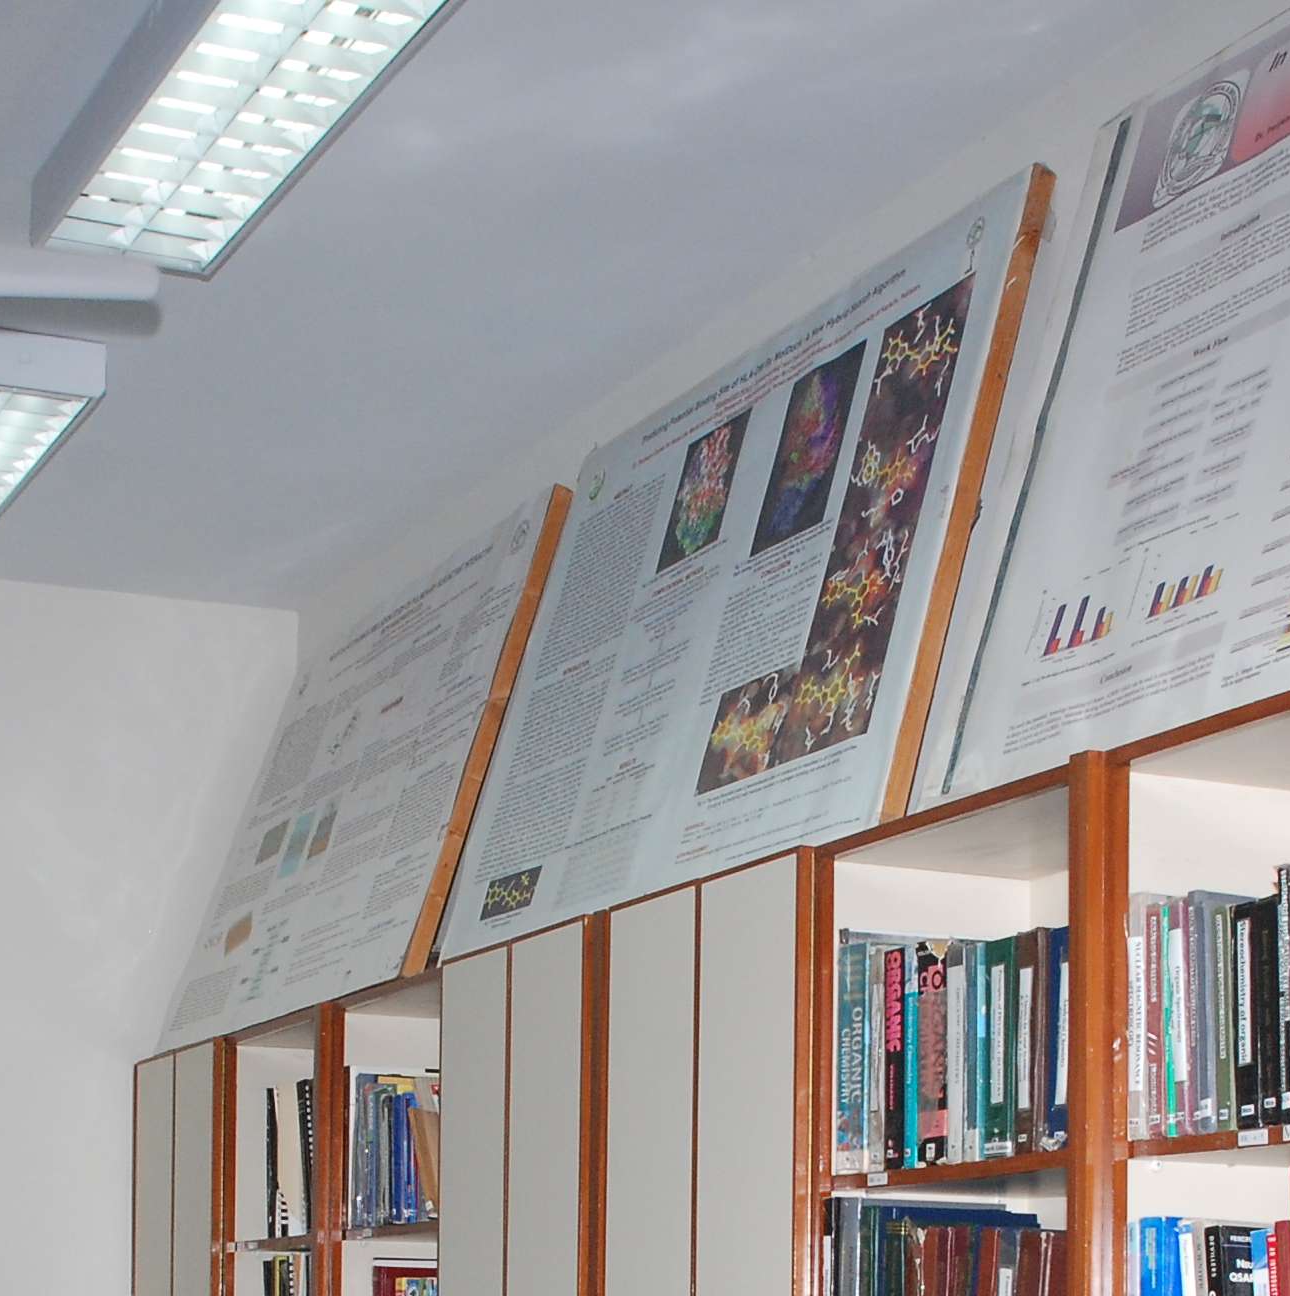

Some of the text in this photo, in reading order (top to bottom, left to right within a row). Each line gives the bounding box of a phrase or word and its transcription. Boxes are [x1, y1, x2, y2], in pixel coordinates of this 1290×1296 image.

[1269, 50, 1287, 72] In
[885, 950, 903, 1053] ORGANIC
[1238, 921, 1248, 1061] Stereochemistry of organic
[840, 1027, 852, 1105] CHEMISTRY
[851, 1006, 865, 1104] ORGANIC
[1134, 1034, 1142, 1084] RESONANCE
